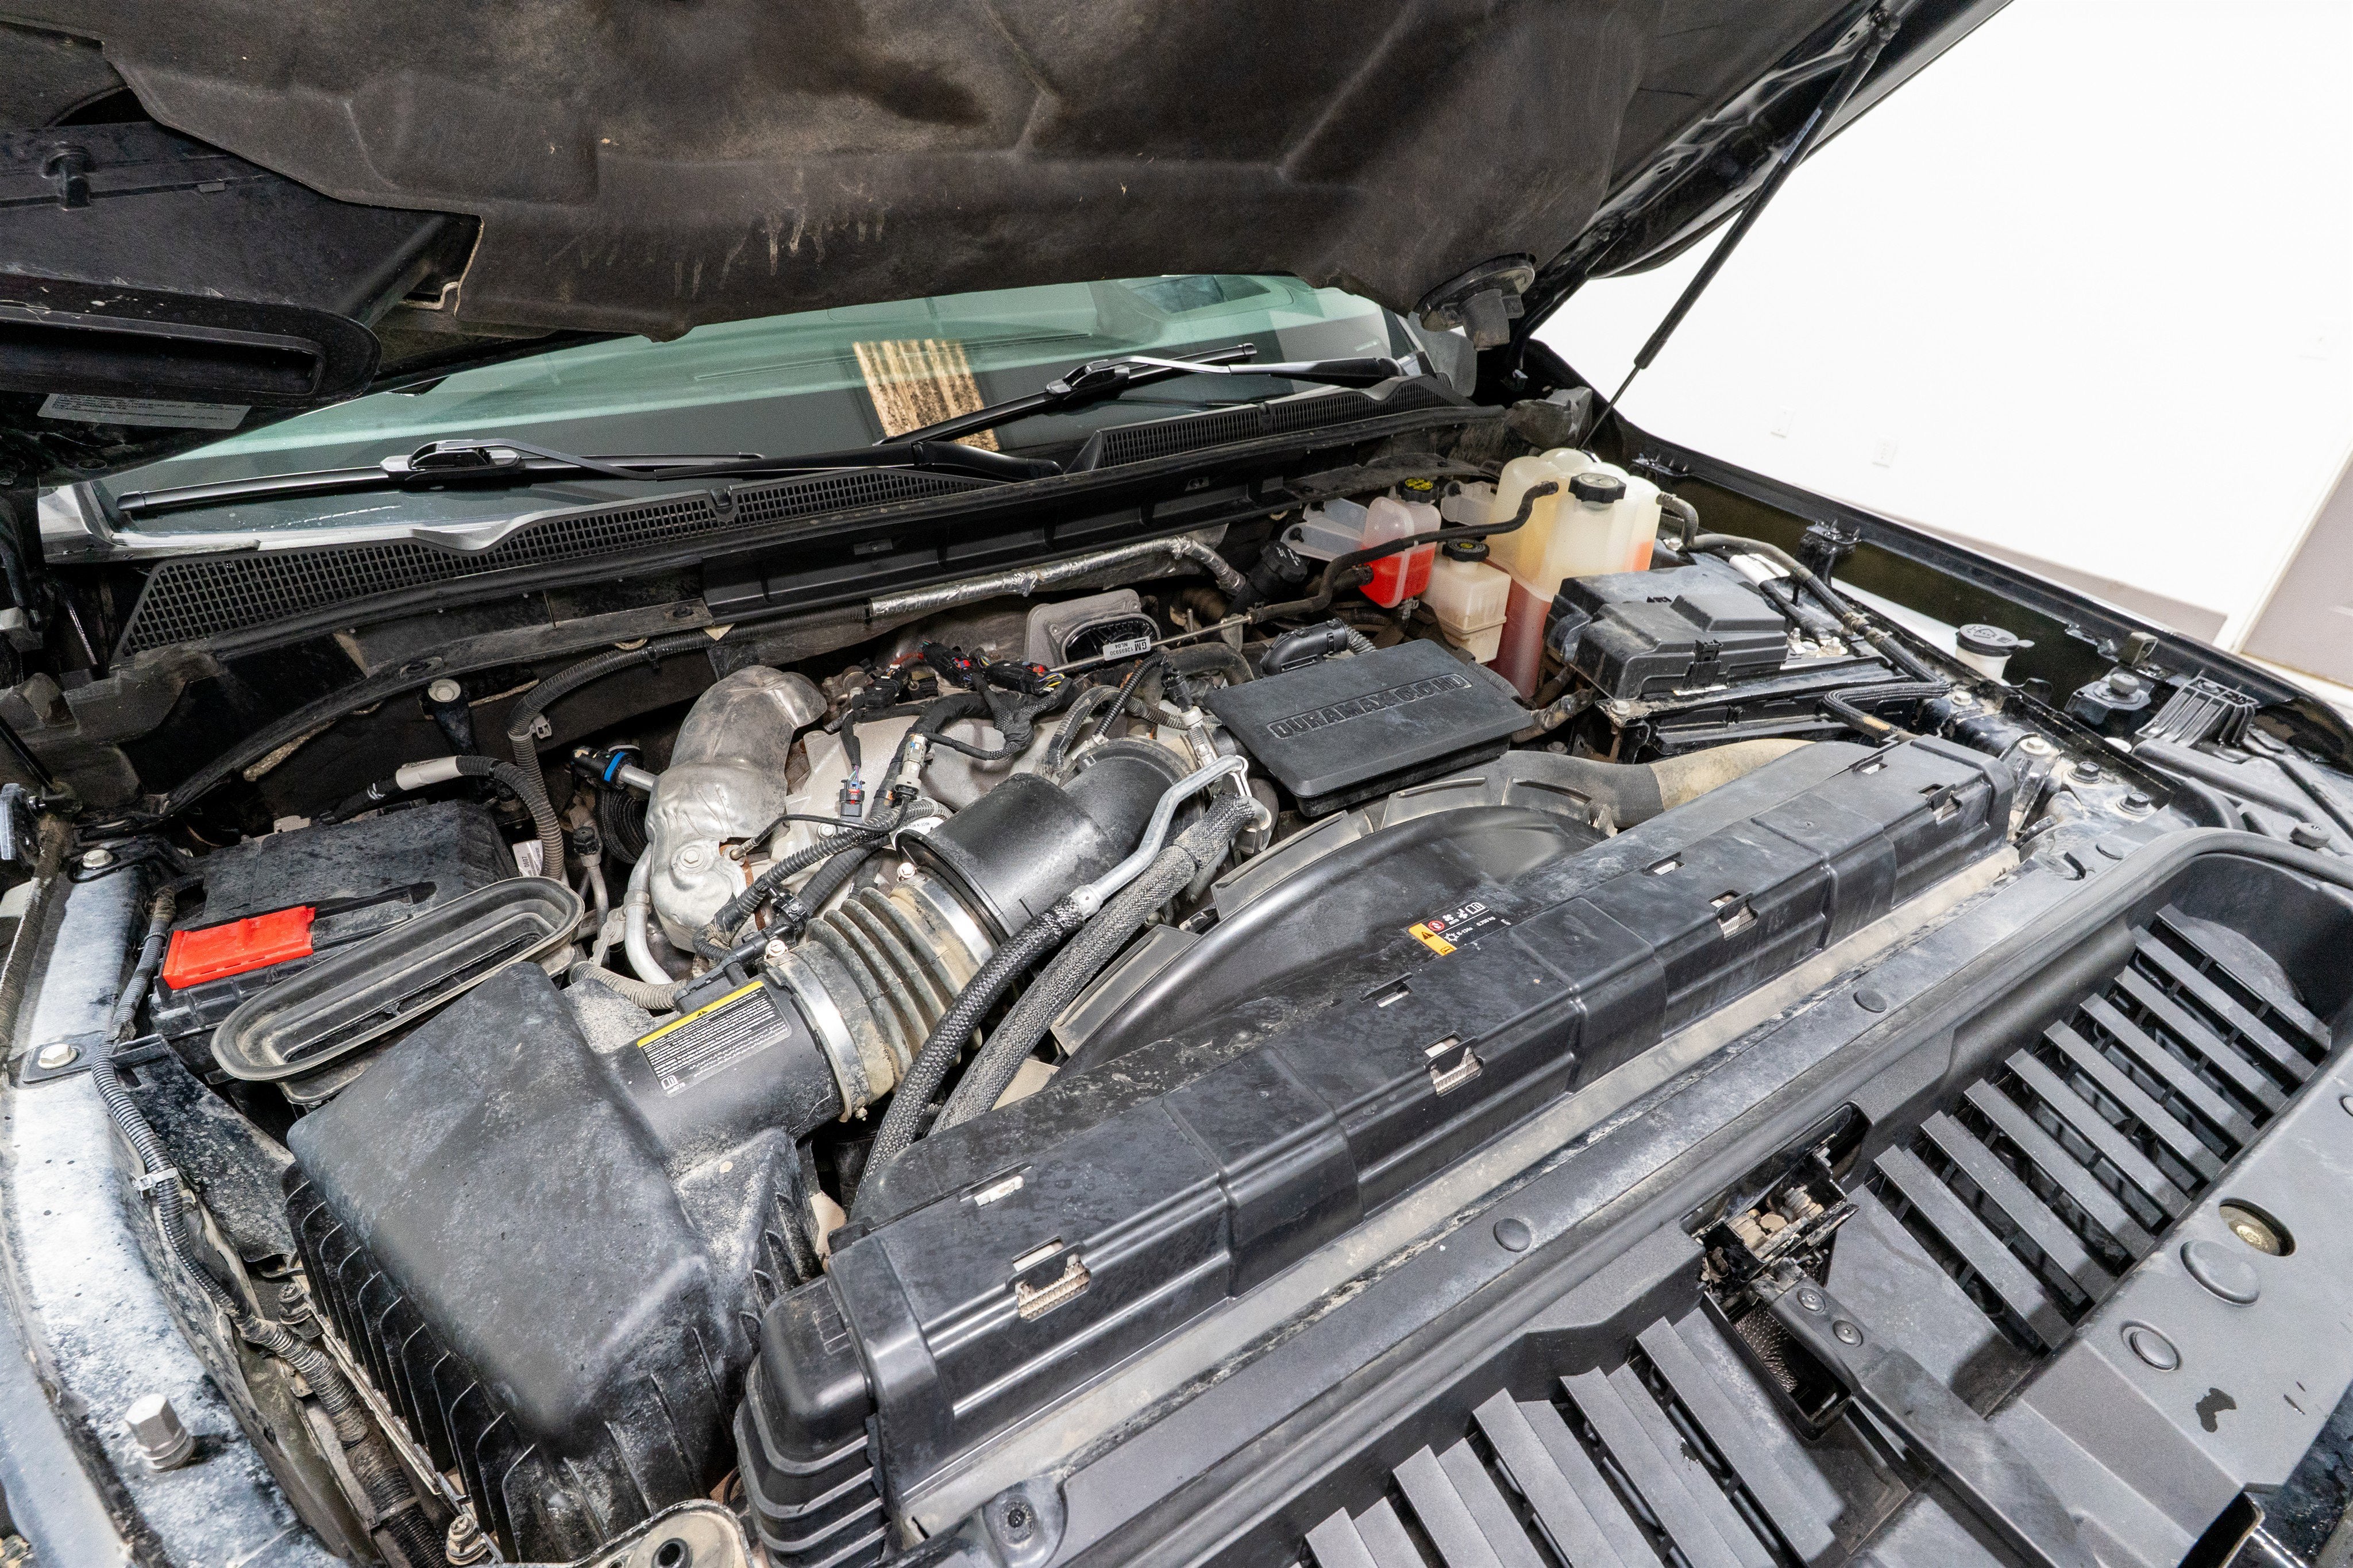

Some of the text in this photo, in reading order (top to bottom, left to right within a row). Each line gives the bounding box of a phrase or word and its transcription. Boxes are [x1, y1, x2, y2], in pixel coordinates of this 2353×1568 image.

[1135, 641, 1147, 651] GM
[1270, 675, 1467, 738] DURAMAX 6.6 HD
